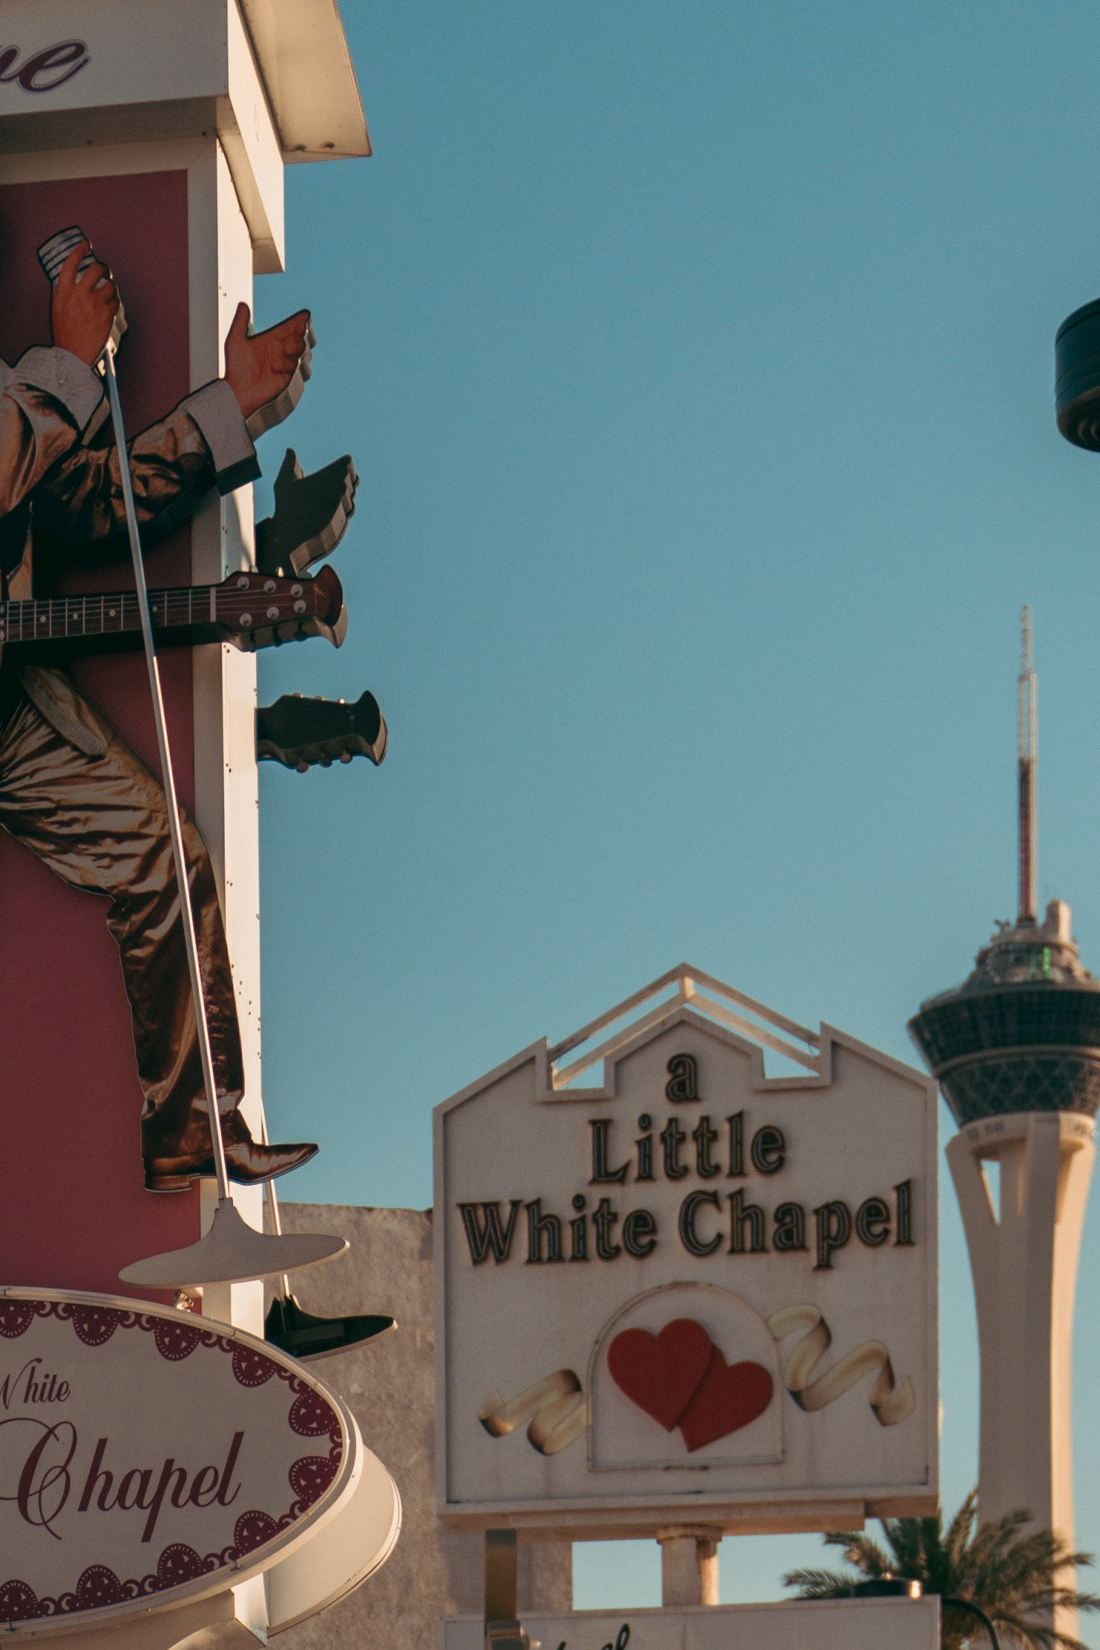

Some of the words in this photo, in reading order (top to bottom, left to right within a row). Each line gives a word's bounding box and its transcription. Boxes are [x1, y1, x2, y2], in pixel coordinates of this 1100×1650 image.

[665, 1052, 701, 1101] a
[587, 1110, 786, 1187] Little
[457, 1193, 657, 1267] White
[678, 1178, 917, 1271] Chapel
